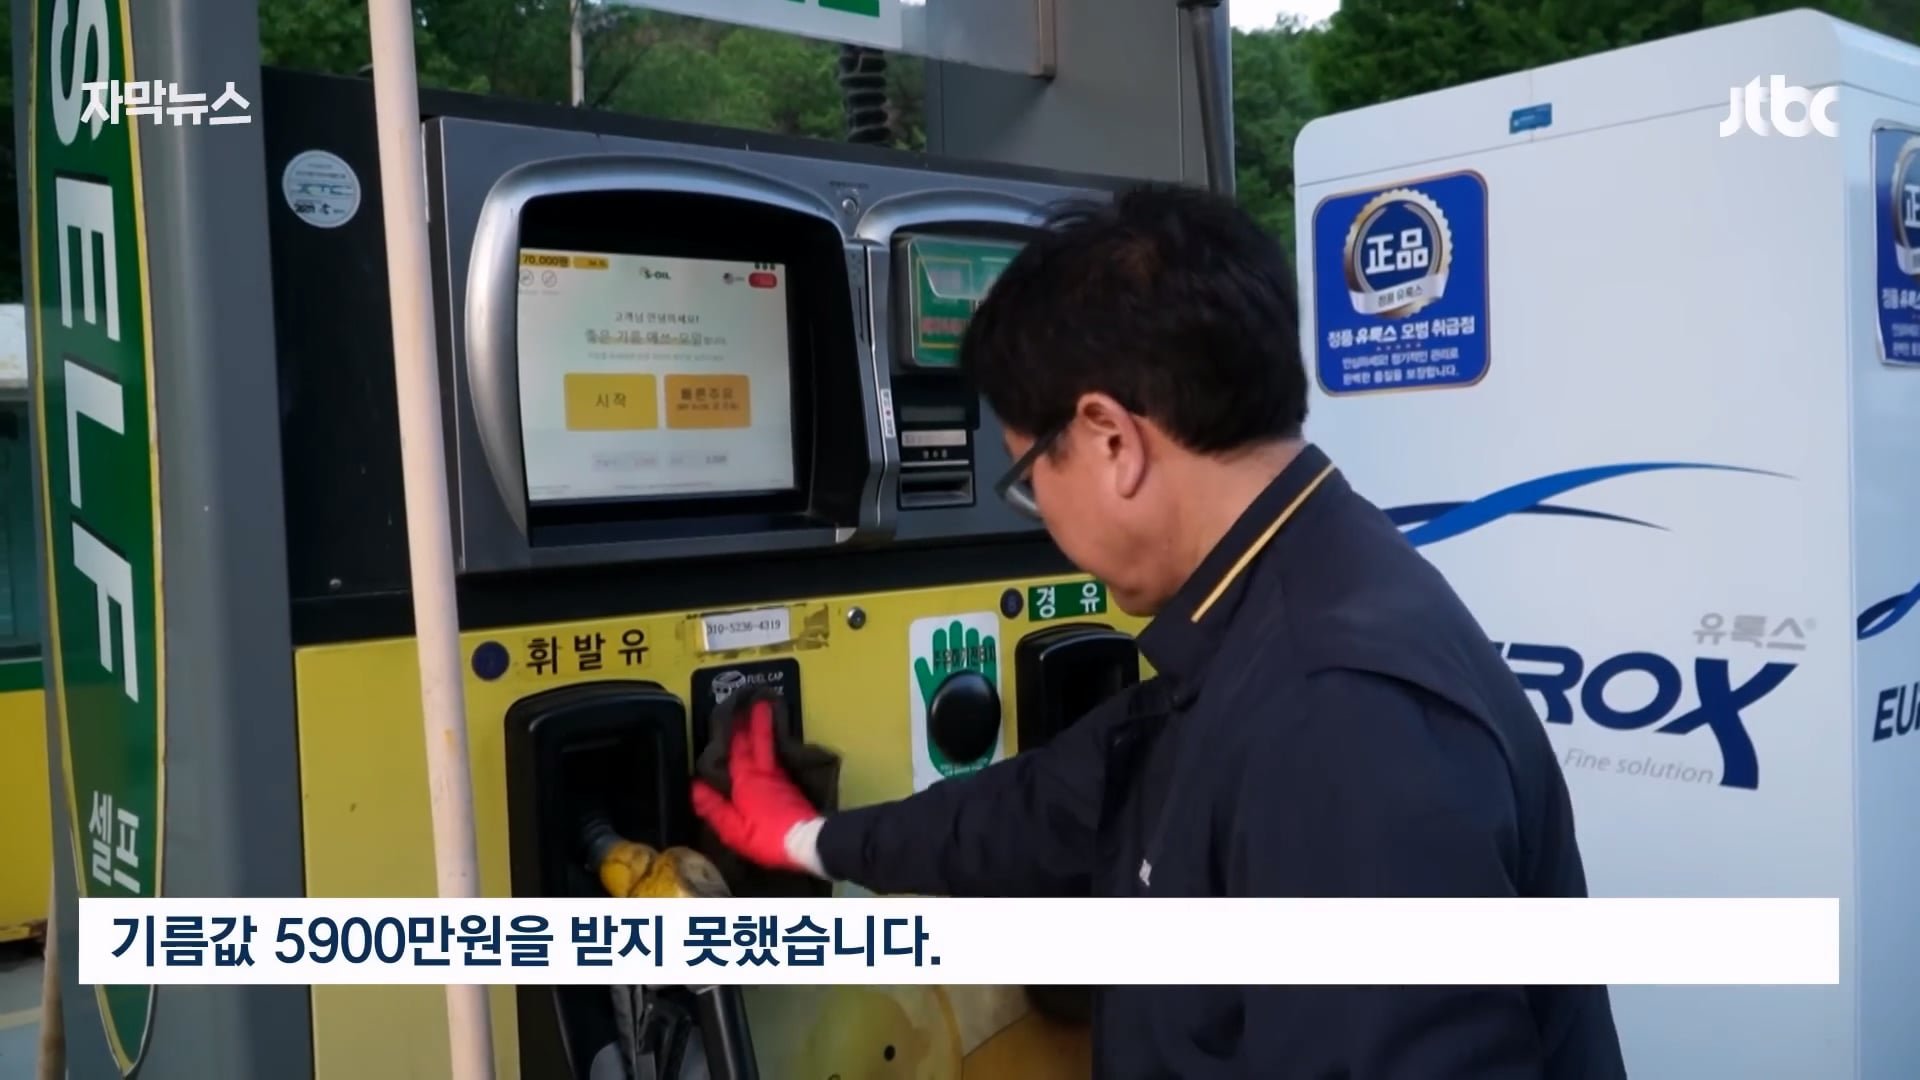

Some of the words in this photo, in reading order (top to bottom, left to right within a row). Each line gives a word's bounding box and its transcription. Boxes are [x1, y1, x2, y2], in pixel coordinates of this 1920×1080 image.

[1366, 227, 1428, 275] 正品
[1431, 315, 1475, 337] 취급점
[595, 393, 627, 408] 시작
[1036, 583, 1100, 619] 경유
[526, 628, 650, 676] 휘발유
[1872, 681, 1920, 743] EU
[1564, 748, 1611, 772] Fine
[1615, 757, 1714, 784] solution
